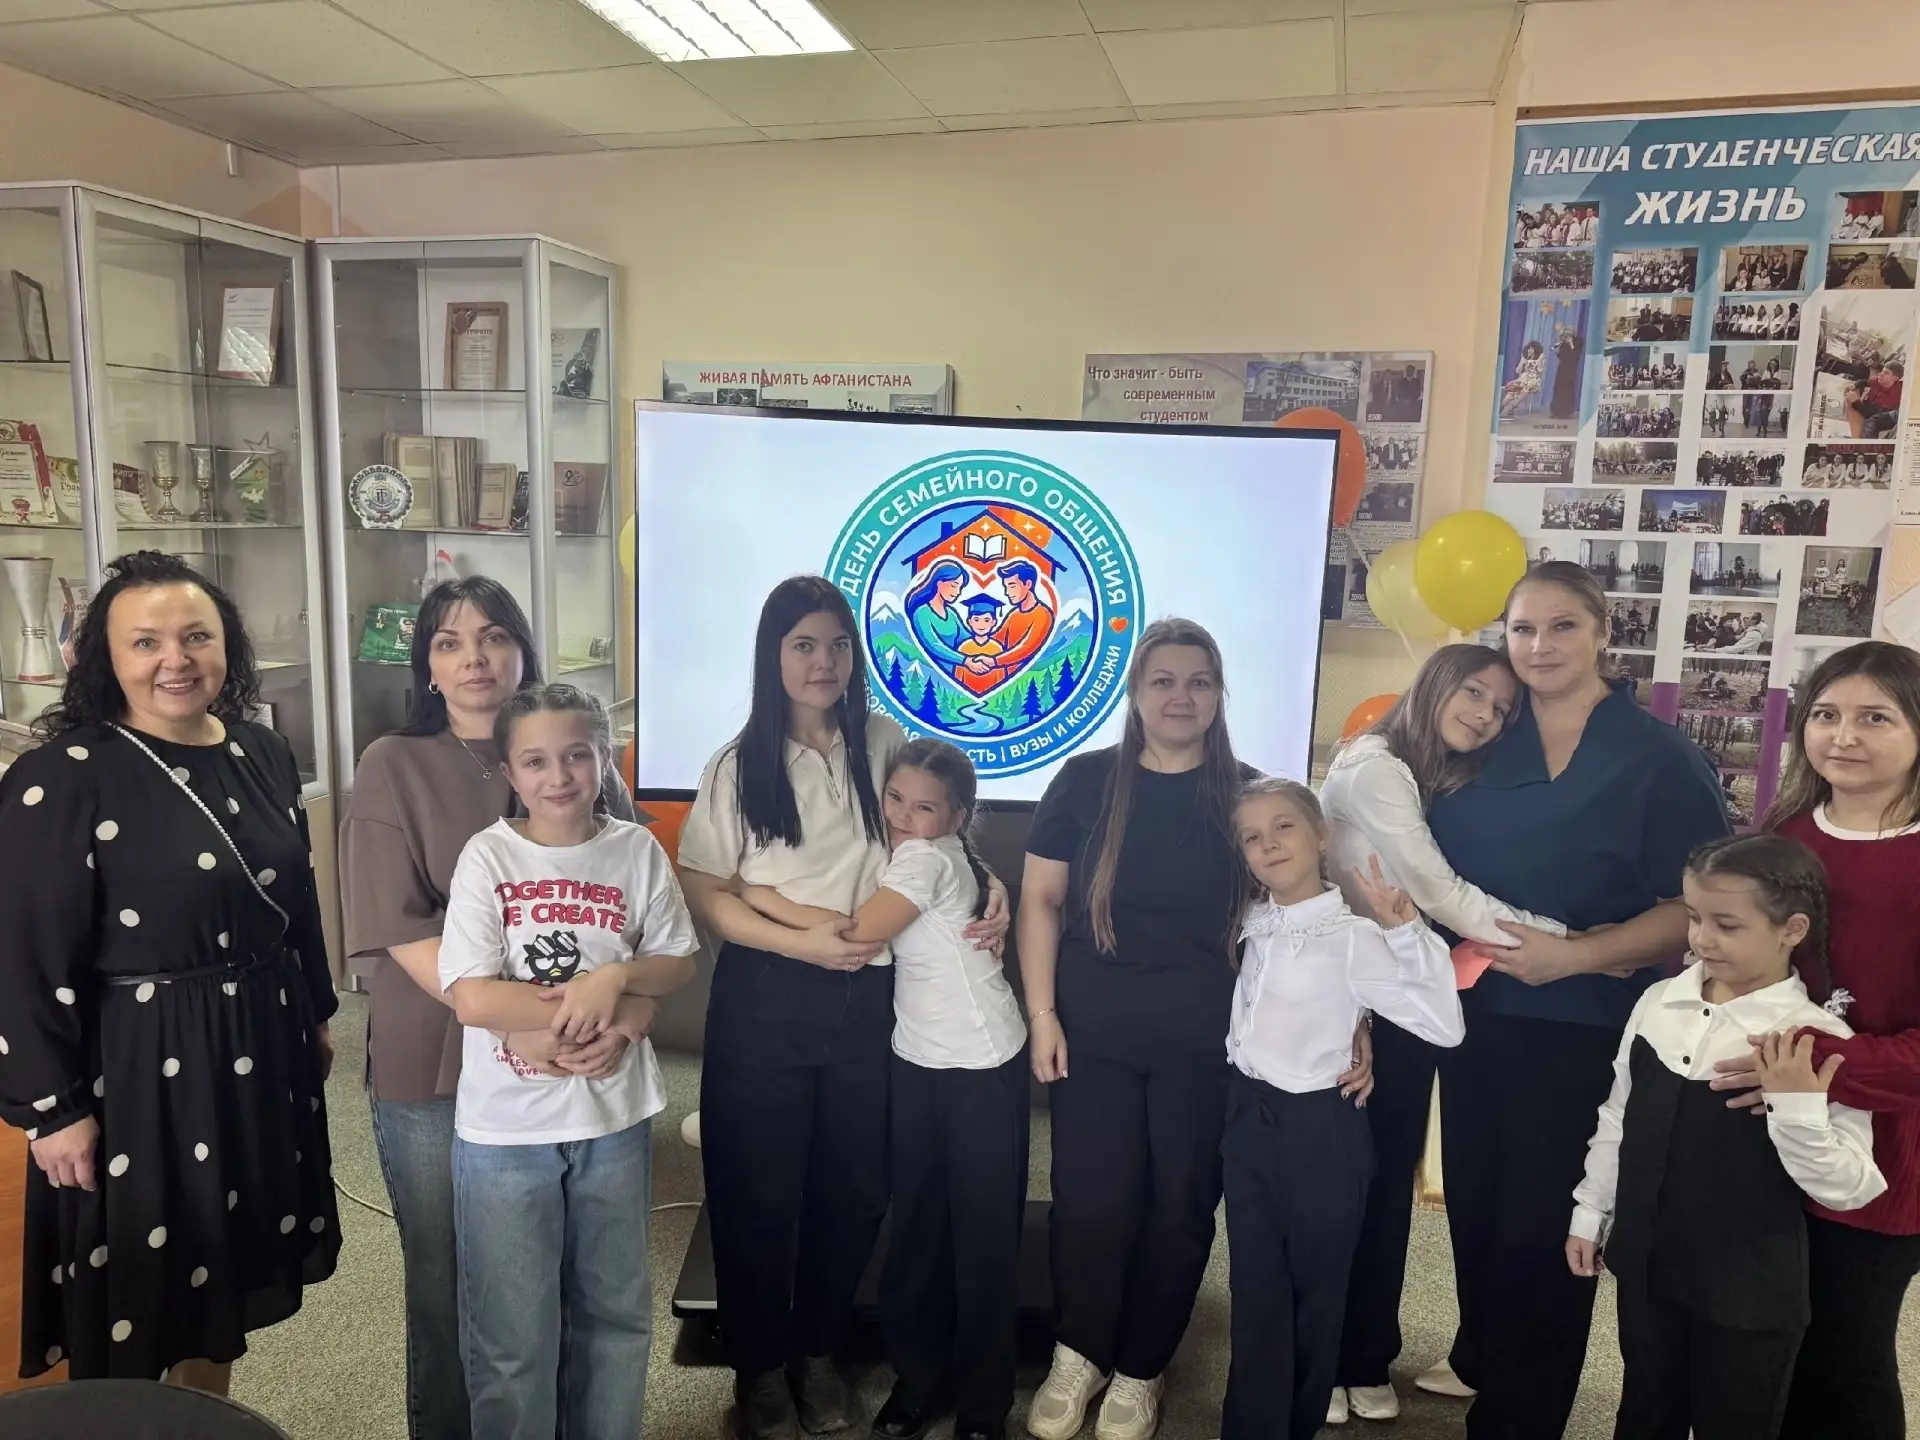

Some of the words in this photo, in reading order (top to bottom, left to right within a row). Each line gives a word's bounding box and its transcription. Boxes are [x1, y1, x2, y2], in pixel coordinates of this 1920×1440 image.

[1523, 145, 1631, 177] НАША
[1640, 131, 1920, 171] СТУДЕНЧЕСКАЯ
[1623, 186, 1807, 226] ЖИЗНЬ
[699, 371, 747, 385] ЖИВАЯ
[751, 372, 809, 387] ПАМЯТЬ
[812, 373, 912, 387] АФГАНИСТАНА
[1088, 366, 1111, 379] Что
[1113, 368, 1158, 379] значит
[1168, 366, 1203, 379] быть
[1123, 389, 1216, 403] современным
[1140, 411, 1209, 424] студентом
[839, 528, 881, 598] ДЕНЬ
[879, 466, 1039, 527] СЕМЕЙНОГО
[1044, 489, 1128, 606] ОБЩЕНИЯ
[1009, 733, 1054, 759] ВУЗЫ
[1056, 723, 1068, 738] И
[1067, 645, 1122, 729] КОЛЛЕДЖИ
[531, 902, 627, 934] CREATE
[496, 1054, 528, 1068] SMLES
